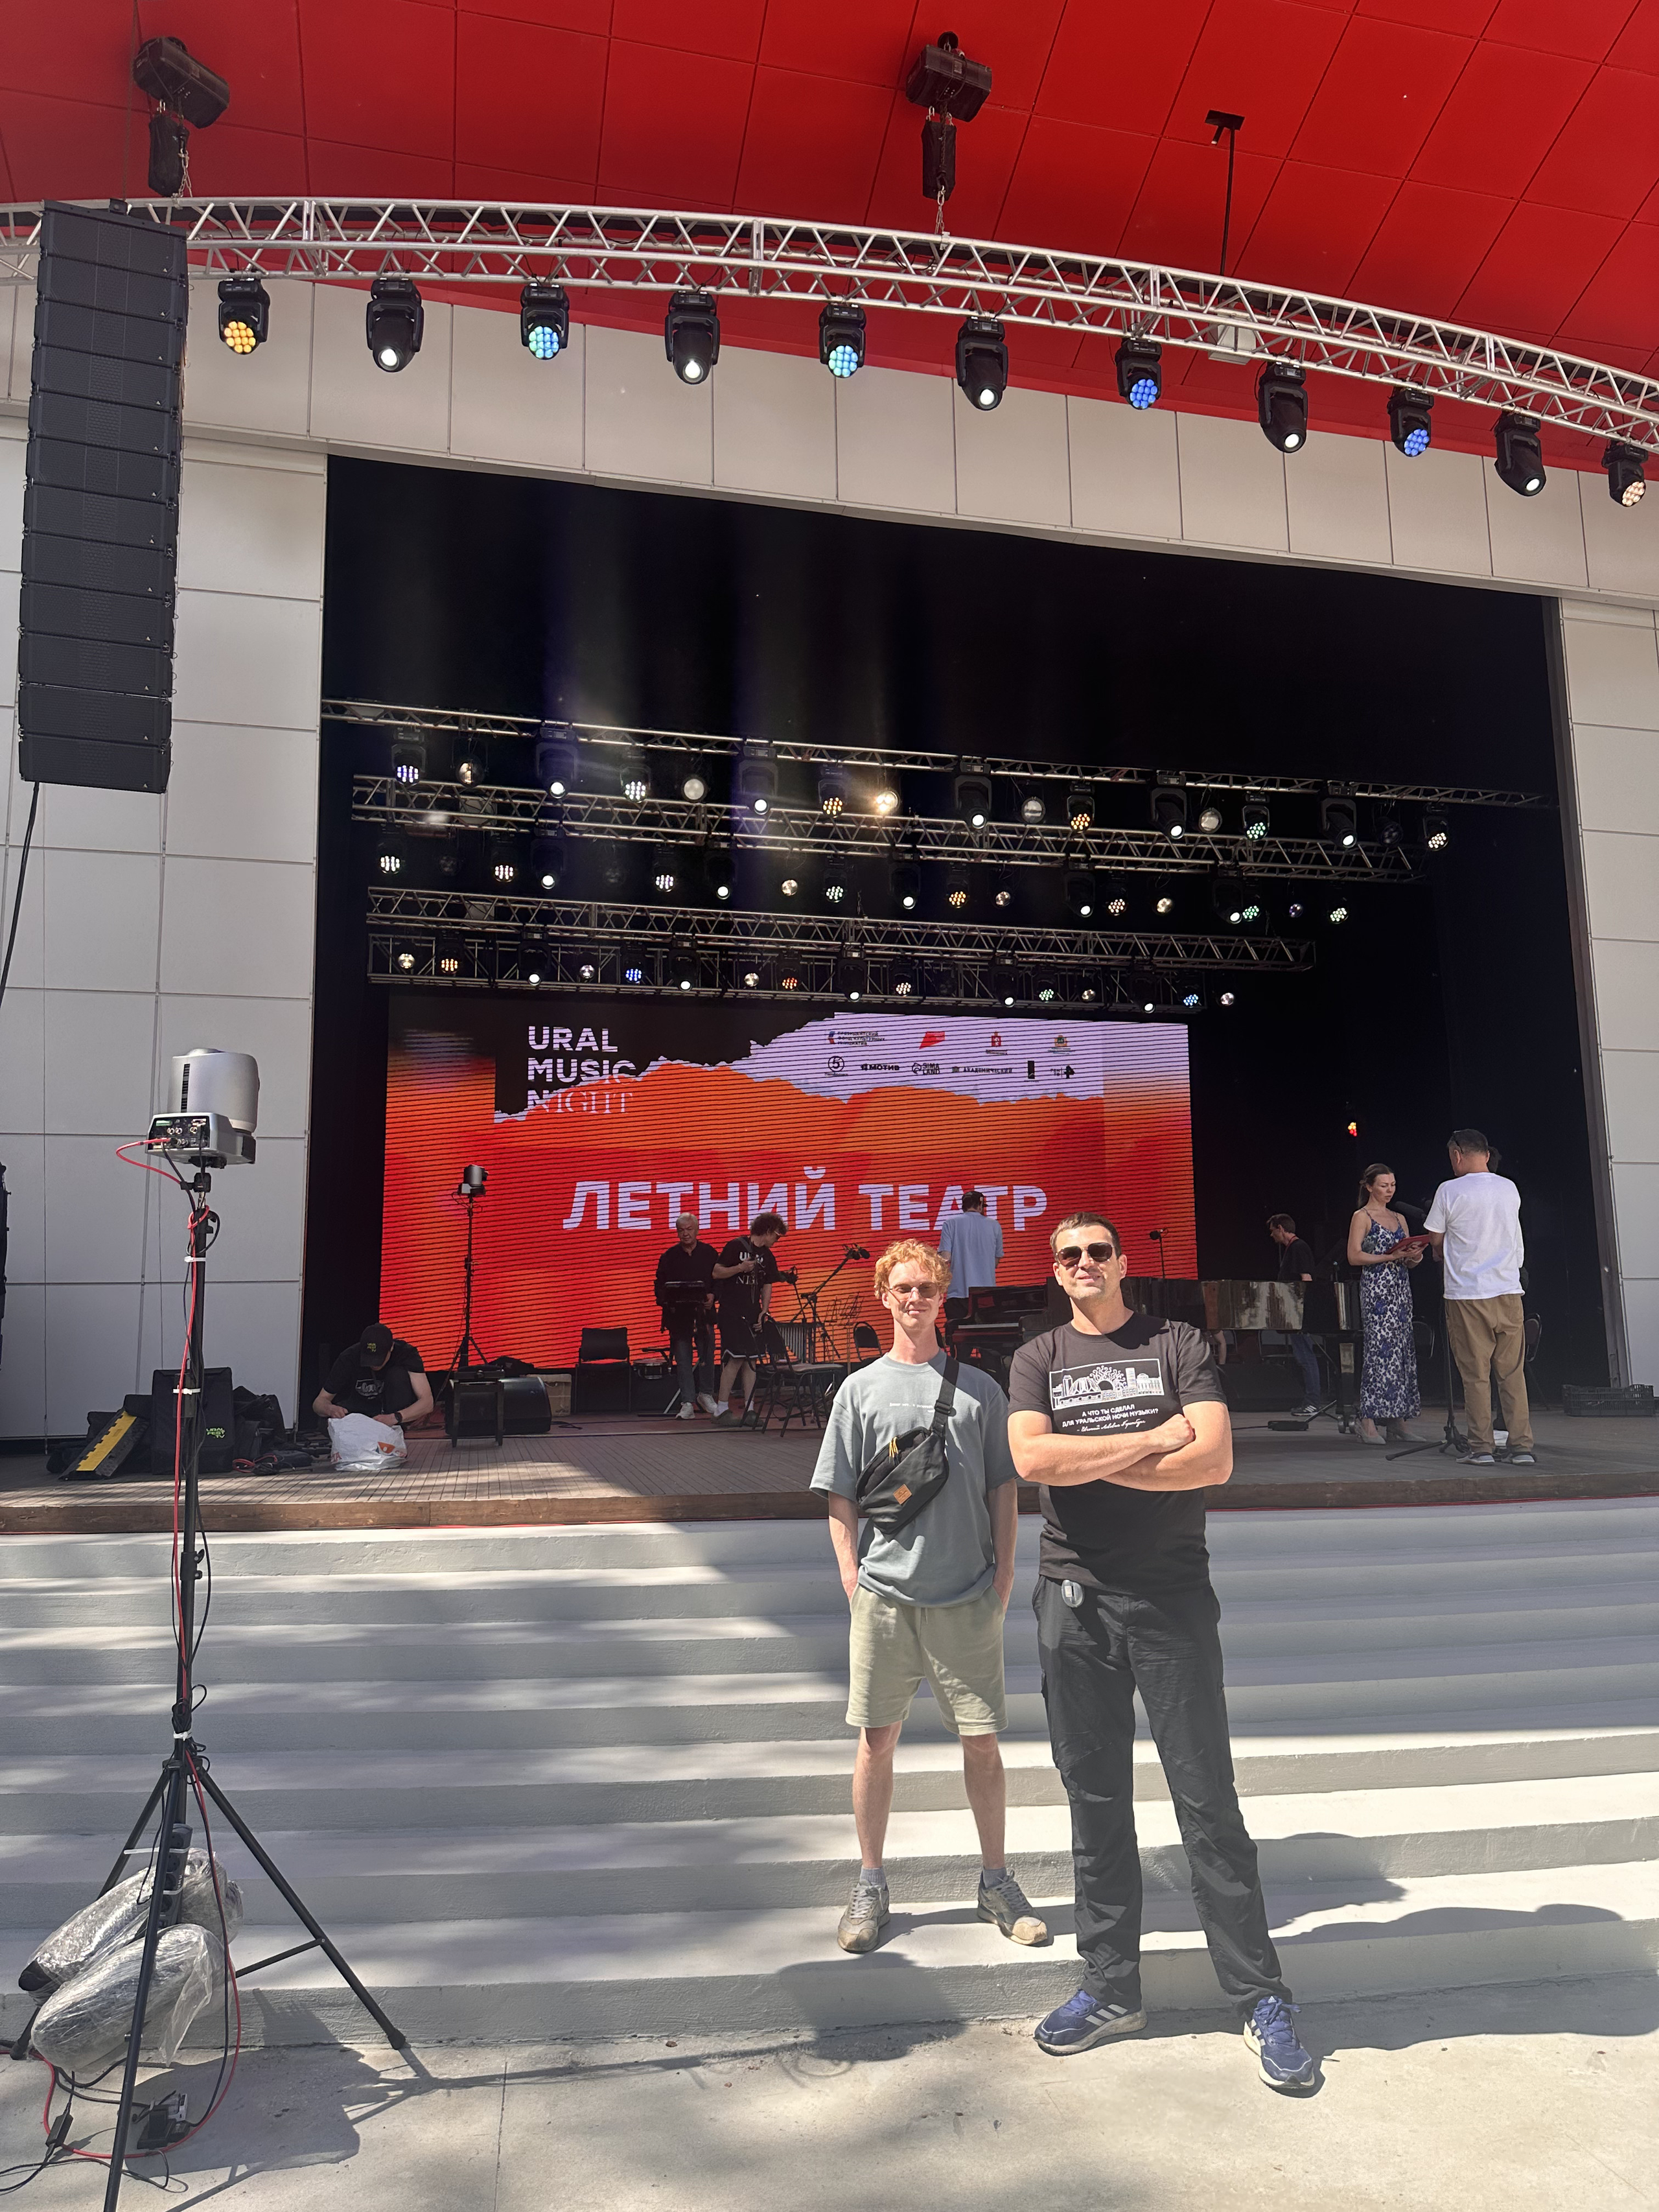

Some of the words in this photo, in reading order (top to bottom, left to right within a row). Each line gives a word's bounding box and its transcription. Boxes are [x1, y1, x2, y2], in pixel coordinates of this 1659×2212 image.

[528, 1026, 618, 1052] URAL
[528, 1058, 636, 1085] MUSIC
[527, 1089, 633, 1113] NIGHT
[563, 1167, 835, 1230] ЛЕТНИЙ
[1075, 1414, 1111, 1425] УРАЛЬСКОЙ
[1129, 1408, 1159, 1417] МУЗЫКИ?
[1110, 1404, 1135, 1414] СДЕЛАЛ
